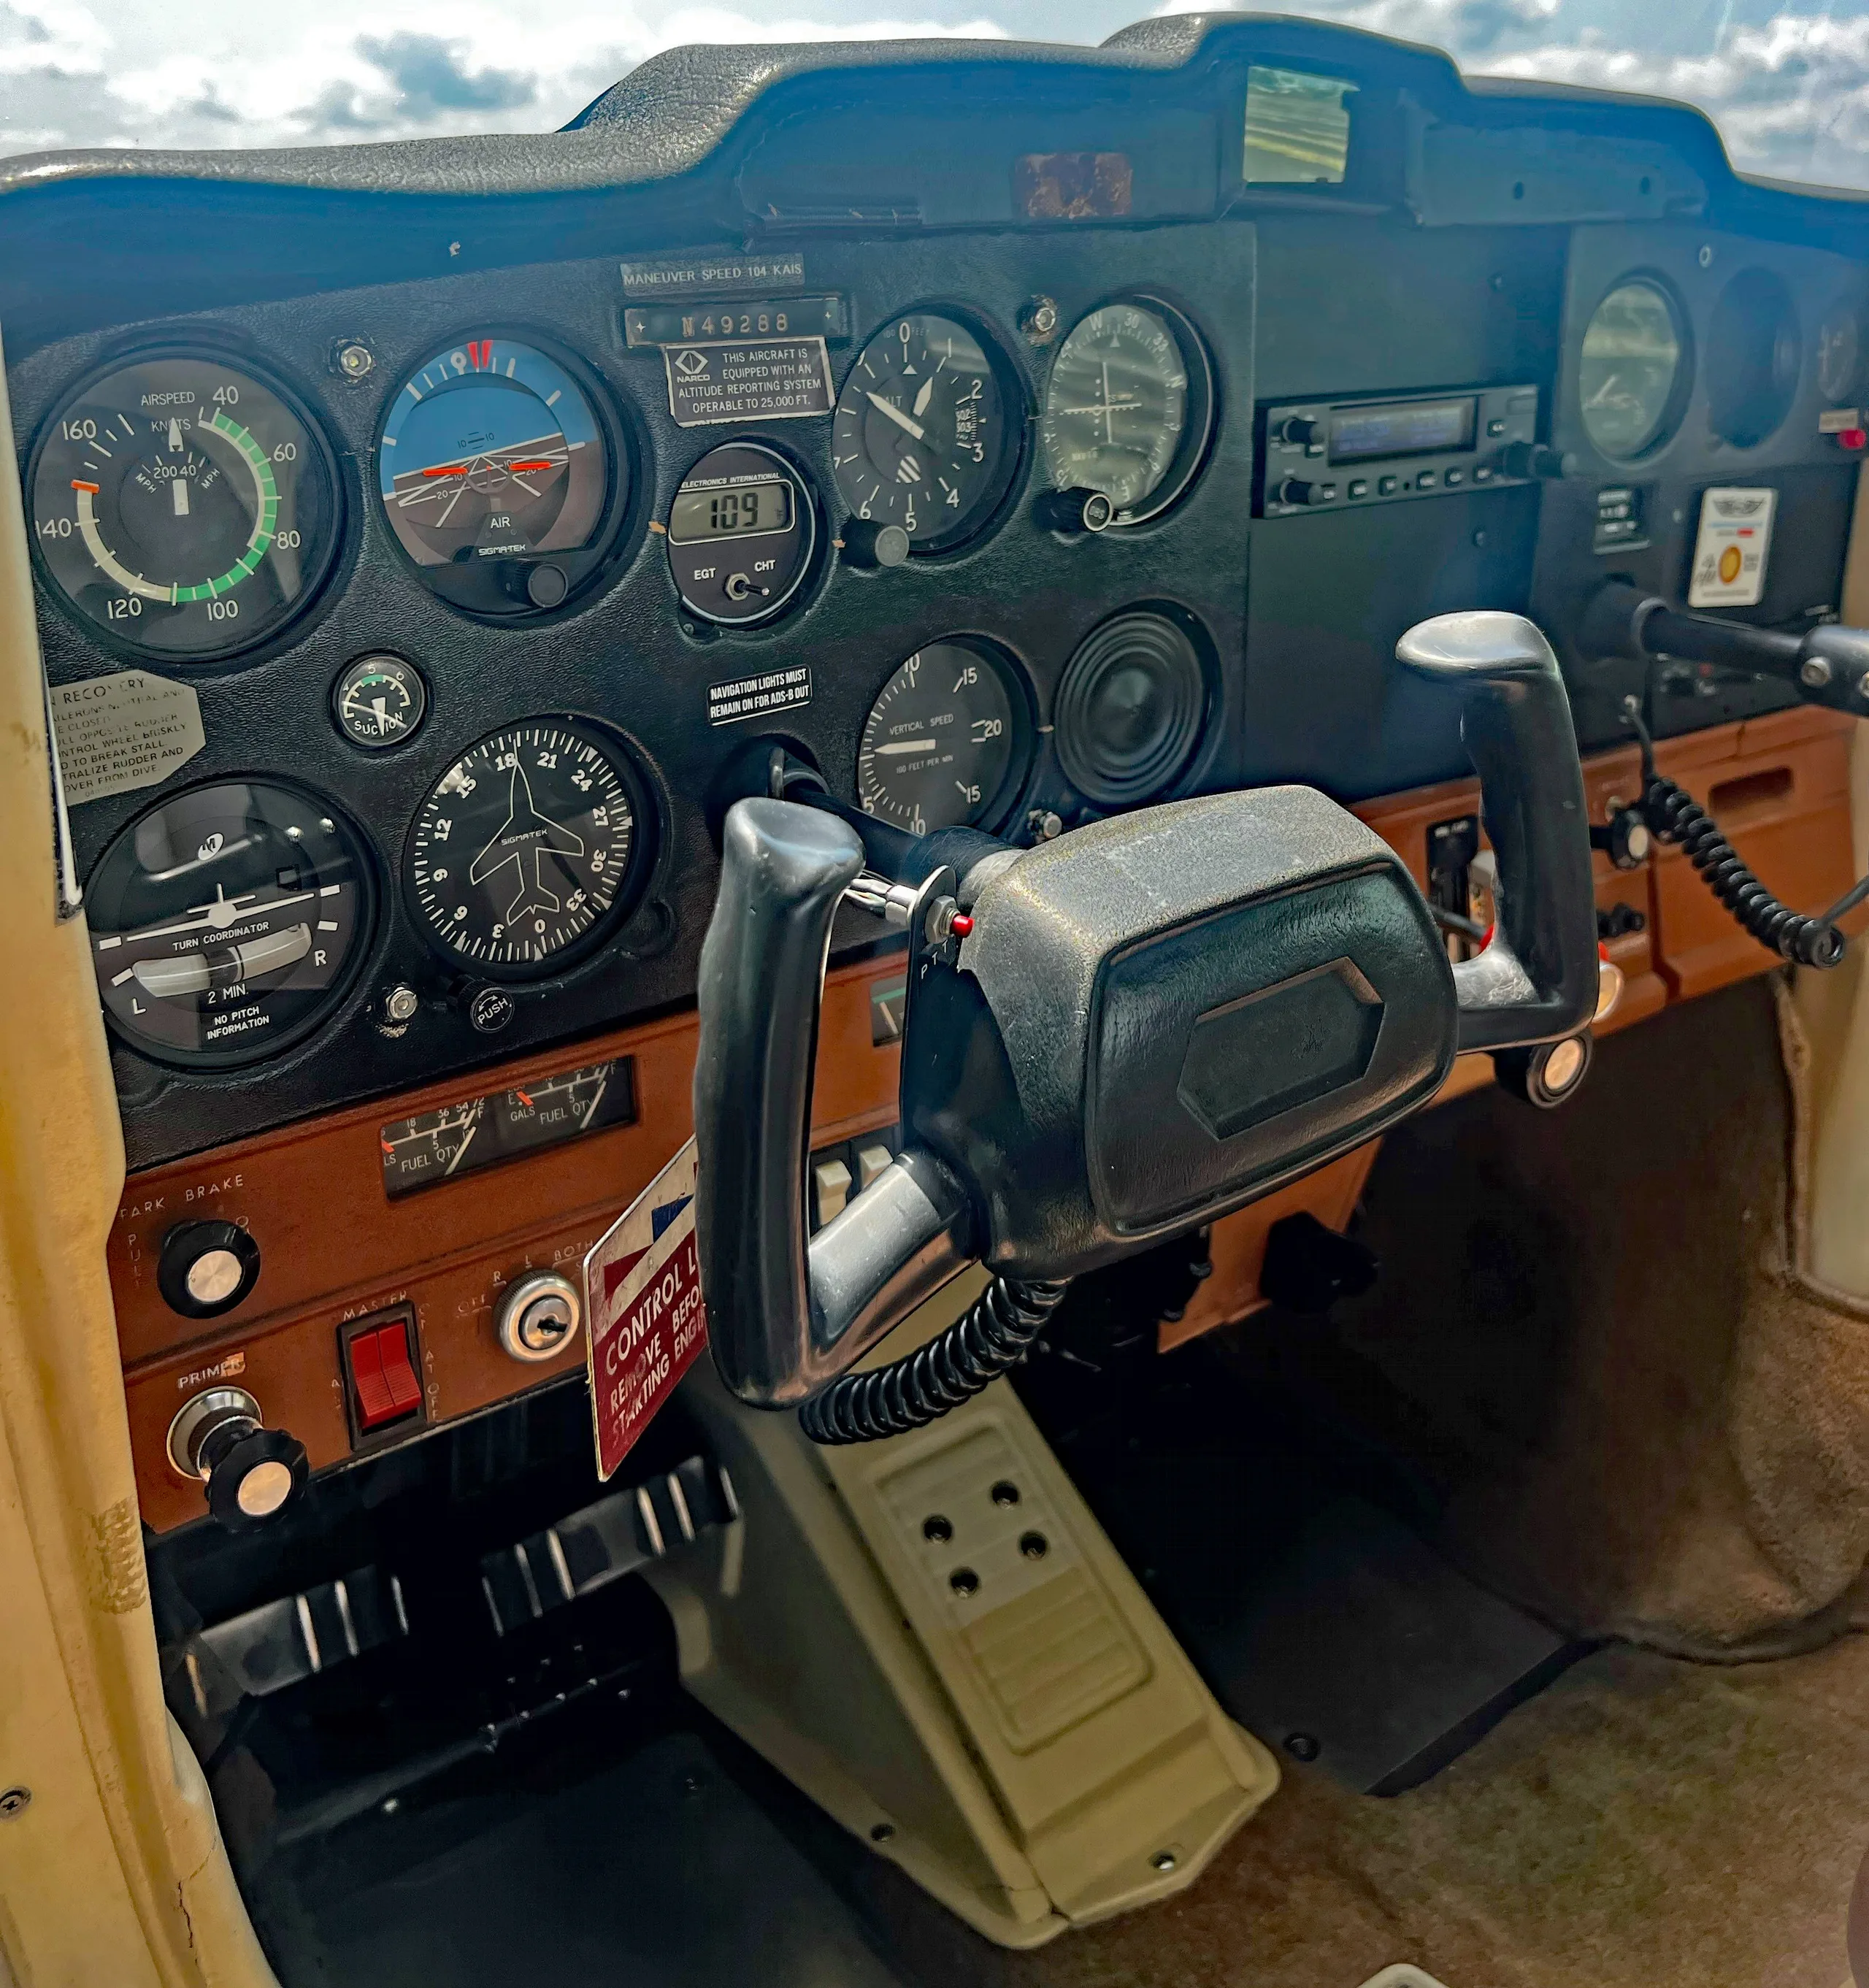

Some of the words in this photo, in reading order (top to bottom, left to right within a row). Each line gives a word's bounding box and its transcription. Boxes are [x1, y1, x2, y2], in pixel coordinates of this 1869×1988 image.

[623, 271, 695, 285] MANEUVER
[702, 267, 741, 280] SPEED
[748, 266, 767, 277] 104
[899, 323, 910, 343] 0
[723, 352, 745, 363] THIS
[749, 349, 794, 361] AIRCRAFT
[799, 348, 807, 358] IS
[677, 375, 710, 383] NARCO
[723, 366, 768, 380] EQUIPPED
[770, 365, 794, 375] WITH
[798, 364, 811, 374] AN
[212, 385, 239, 404] 40
[679, 385, 724, 399] ALTITUDE
[727, 380, 780, 394] REPORTING
[783, 379, 821, 390] SYSTEM
[971, 380, 983, 399] 2
[141, 391, 195, 407] AIRSPEED
[694, 400, 743, 413] OPERABLE
[745, 399, 758, 409] TO
[761, 396, 794, 408] 25,000
[796, 394, 810, 405] FT.
[63, 420, 97, 440] 160
[151, 418, 191, 432] KNTS
[273, 442, 297, 461] 60
[972, 443, 983, 462] 3
[153, 466, 177, 478] 200
[179, 464, 196, 477] 40
[201, 467, 220, 490] MPH
[682, 477, 727, 488] ELECTRONICS
[729, 472, 780, 483] INTERNATIONAL
[135, 473, 156, 494] MPH
[437, 490, 448, 499] 20
[946, 488, 959, 507] 4
[710, 492, 759, 529] 109
[860, 501, 872, 520] 6
[36, 518, 72, 540] 140
[491, 517, 510, 529] AIR
[905, 512, 917, 531] 5
[277, 531, 301, 550] 80
[694, 568, 715, 580] EGT
[754, 560, 775, 572] CHT
[107, 597, 142, 619] 120
[207, 600, 239, 621] 100
[368, 664, 376, 674] 5
[396, 671, 404, 680] 6
[963, 667, 978, 686] 15
[710, 680, 758, 700] NAVIGATION
[759, 673, 785, 690] LIGHTS
[786, 669, 806, 684] MUST
[710, 702, 741, 718] REMAIN
[742, 701, 753, 711] ON
[754, 694, 769, 708] FOR
[771, 688, 794, 705] ADS-B
[795, 685, 809, 698] OUT
[355, 711, 403, 735] SUCION
[889, 721, 924, 736] VERTICAL
[930, 713, 954, 727] SPEED
[984, 719, 1002, 737] 20
[59, 741, 98, 759] NTROL
[73, 758, 87, 767] TO
[92, 748, 127, 764] BREAK
[63, 767, 108, 780] TRALIZE
[113, 753, 158, 770] RUDDER
[161, 746, 184, 759] AND
[495, 753, 517, 771] 18
[537, 751, 557, 769] 21
[64, 780, 93, 794] OVER
[98, 771, 128, 784] FROM
[456, 775, 477, 799] 15
[571, 770, 593, 792] 24
[966, 786, 981, 804] 15
[863, 797, 875, 814] 5
[592, 806, 609, 827] 27
[434, 818, 452, 841] 12
[591, 849, 607, 872] 30
[567, 888, 586, 910] 33
[492, 924, 505, 938] 3
[534, 919, 545, 933] 0
[173, 938, 199, 951] TURN
[203, 921, 269, 944] COORDINATOR
[314, 949, 327, 967] R
[921, 940, 948, 979] PTT
[208, 991, 216, 1005] 2
[223, 983, 249, 1000] MIN.
[133, 999, 146, 1015] L
[214, 1015, 228, 1025] NO
[231, 1006, 259, 1021] PITCH
[477, 998, 508, 1024] PUSH
[207, 1016, 269, 1040] INFORMATION
[569, 1094, 575, 1104] 5
[477, 1107, 483, 1118] F
[510, 1106, 535, 1121] GALS
[540, 1107, 568, 1124] FUEL
[433, 1140, 439, 1150] 5
[384, 1154, 396, 1166] LS
[402, 1154, 431, 1173] FUEL
[437, 1143, 459, 1163] QTY
[120, 1197, 165, 1219] PARK
[185, 1174, 244, 1202] BRAKE
[525, 1254, 531, 1264] L
[493, 1271, 502, 1282] R
[607, 1263, 682, 1375] CONTROL
[610, 1332, 661, 1416] REMOVE
[672, 1285, 699, 1334] BEFO
